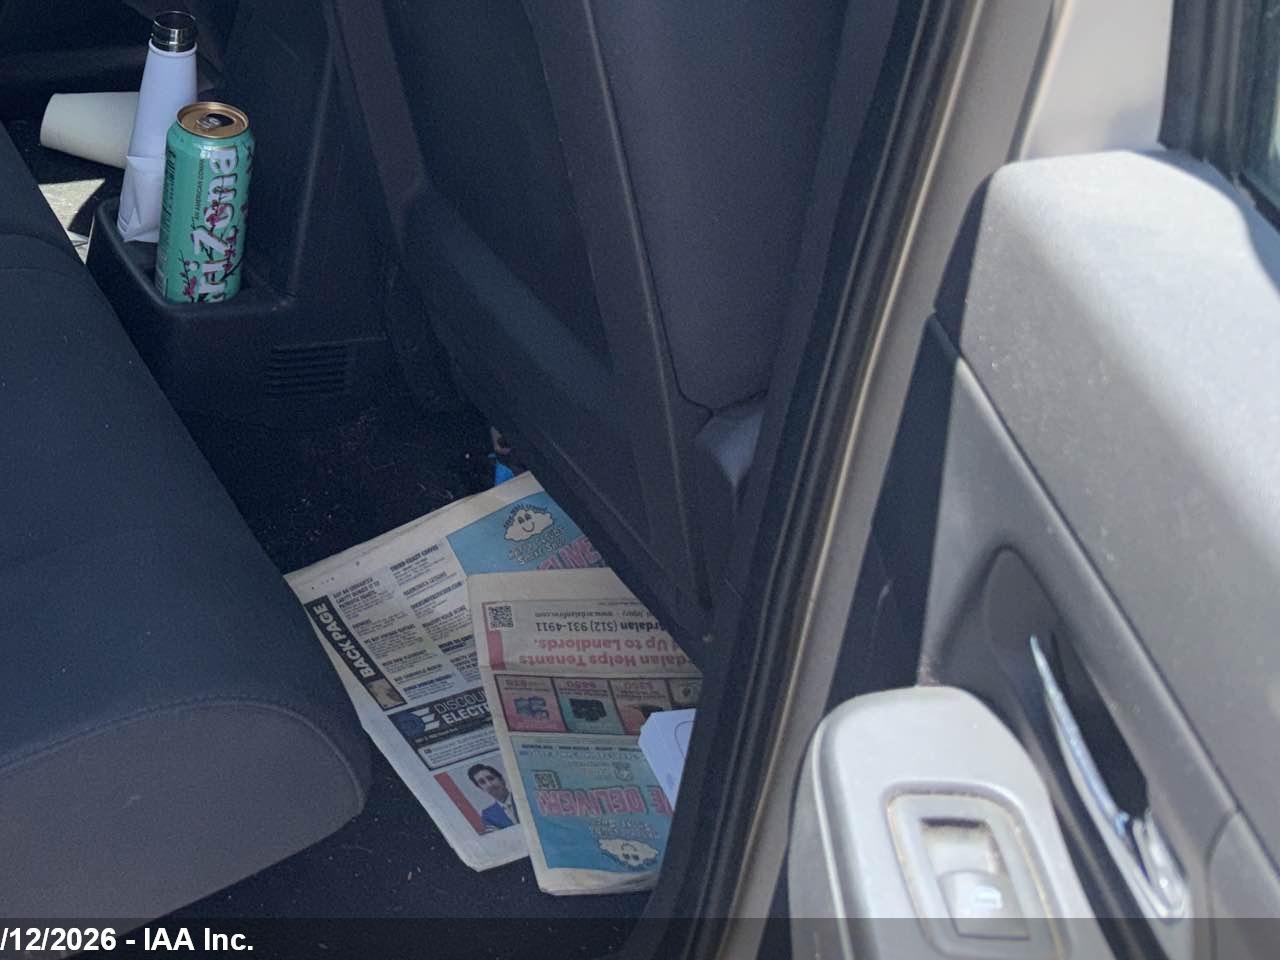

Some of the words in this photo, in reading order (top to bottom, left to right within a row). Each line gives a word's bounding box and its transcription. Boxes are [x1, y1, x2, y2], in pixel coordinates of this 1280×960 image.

[313, 603, 344, 641] PAGE
[536, 622, 588, 632] 931-4911
[590, 621, 617, 632] (512)
[626, 640, 642, 650] to
[645, 639, 668, 651] Up
[338, 640, 375, 679] BACK
[520, 655, 587, 666] Tenants
[589, 653, 636, 666] Helps
[640, 655, 688, 666] dalan
[434, 690, 486, 714] DISCOU
